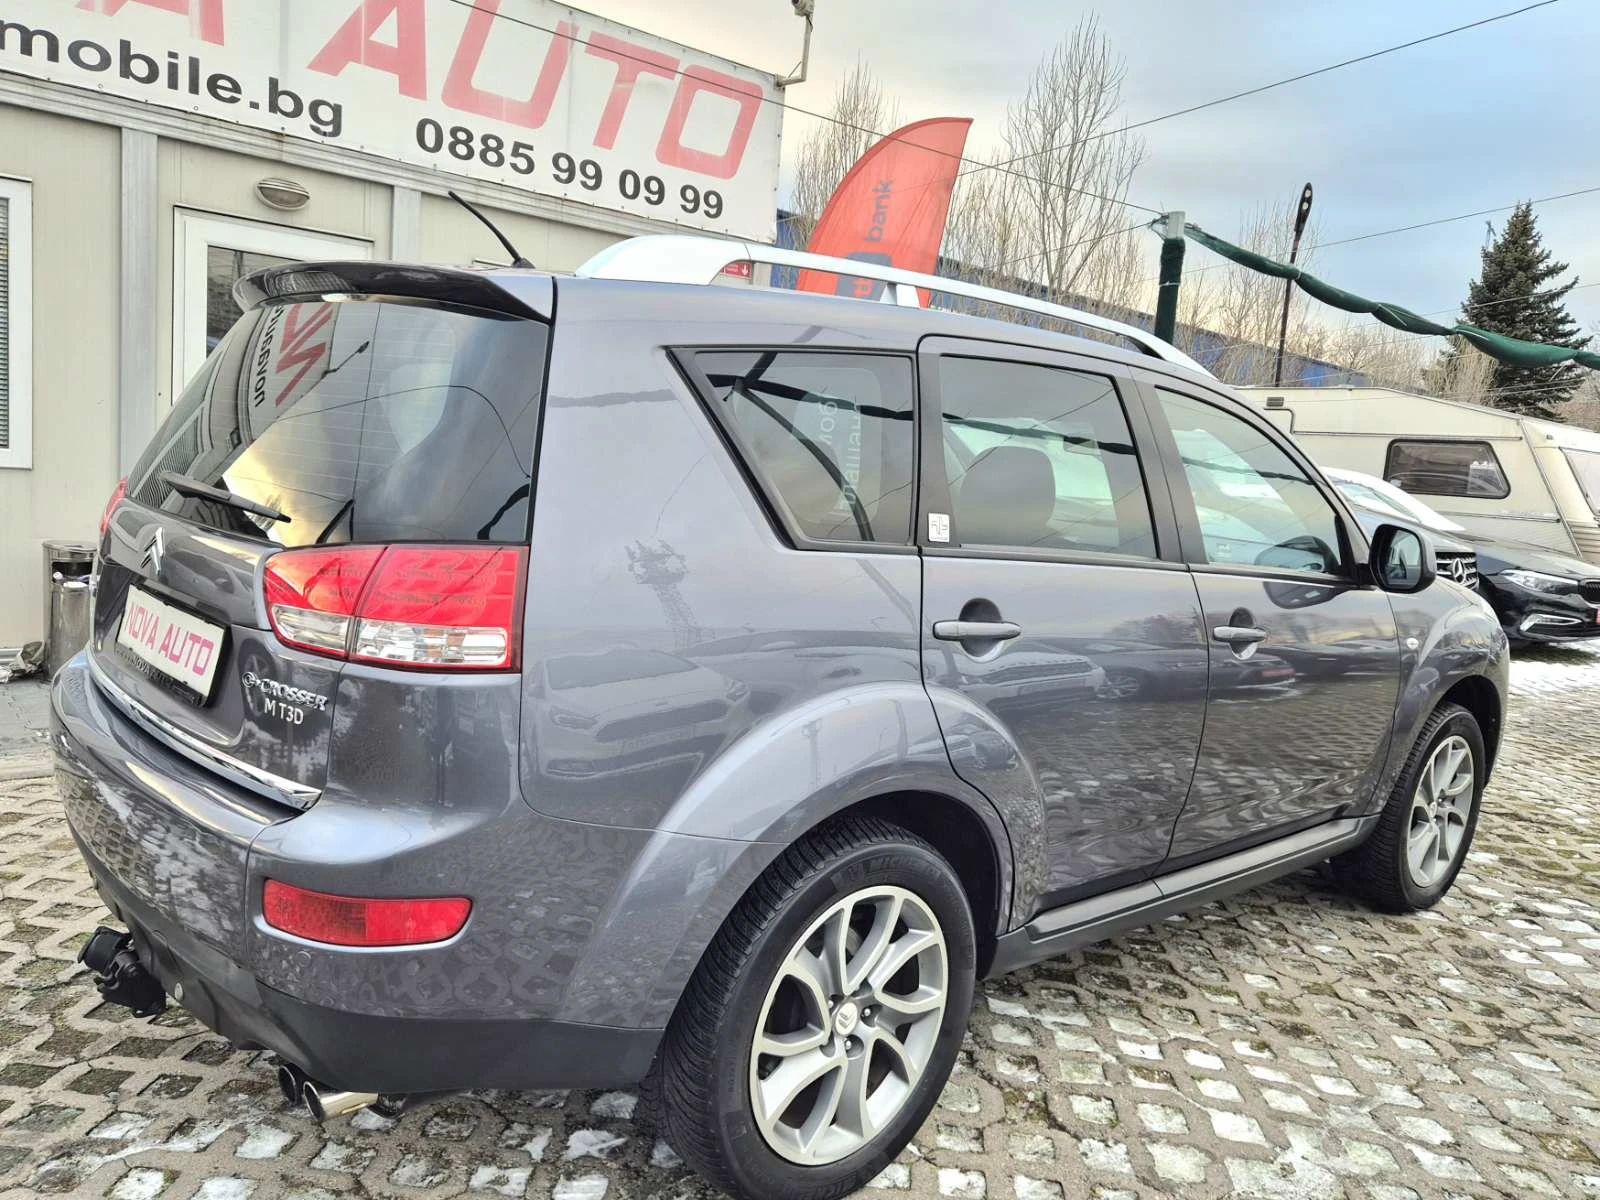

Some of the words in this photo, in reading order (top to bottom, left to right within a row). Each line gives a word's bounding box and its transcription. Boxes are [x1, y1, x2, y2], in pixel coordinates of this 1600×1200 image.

[0, 20, 342, 138] mobile.bg
[306, 0, 764, 180] AUTO
[416, 117, 536, 175] 0885
[551, 152, 603, 191] 99
[618, 169, 666, 206] 09
[679, 184, 724, 219] 99
[864, 180, 894, 242] bank
[125, 602, 161, 650] NOVA
[158, 623, 214, 676] AUTO
[264, 697, 276, 717] M
[278, 702, 304, 724] T3D
